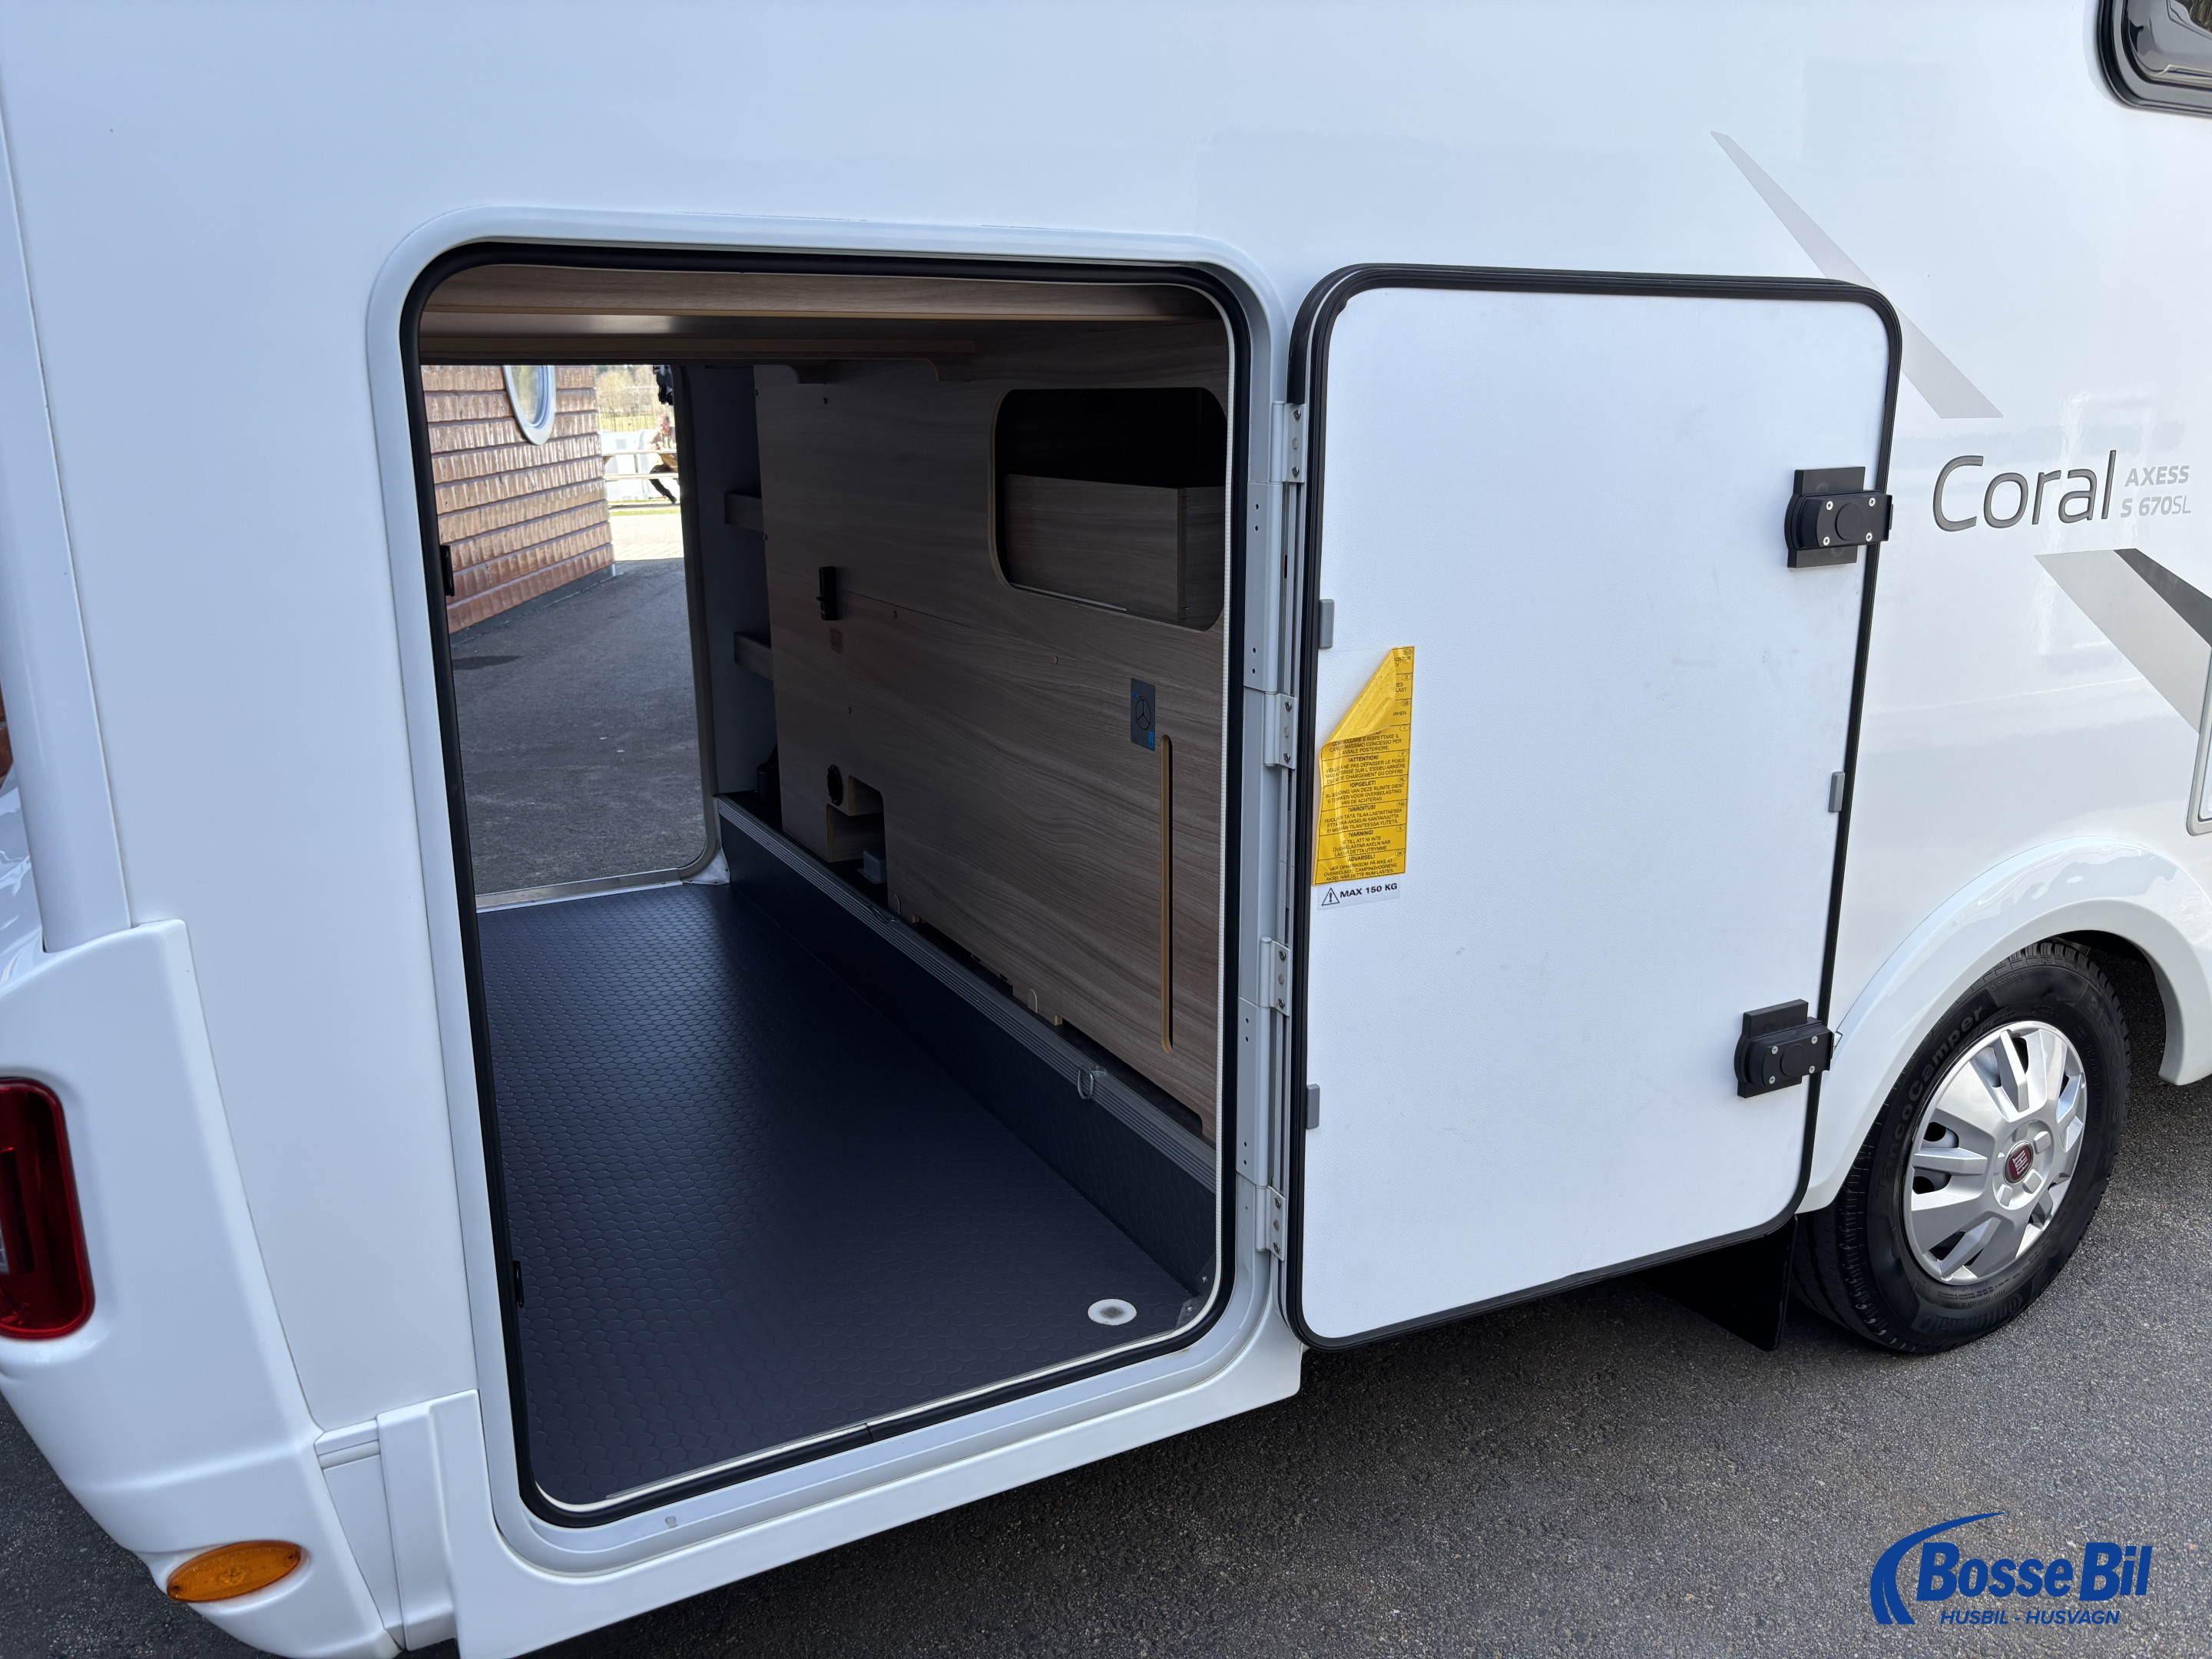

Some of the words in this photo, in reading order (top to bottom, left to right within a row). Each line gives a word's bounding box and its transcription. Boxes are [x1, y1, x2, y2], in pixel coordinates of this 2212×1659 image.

[2124, 465, 2190, 487] AXESS
[1933, 450, 2117, 531] Coral
[2121, 498, 2133, 518] S
[2138, 495, 2190, 516] 670SL
[1340, 888, 1362, 898] MAX
